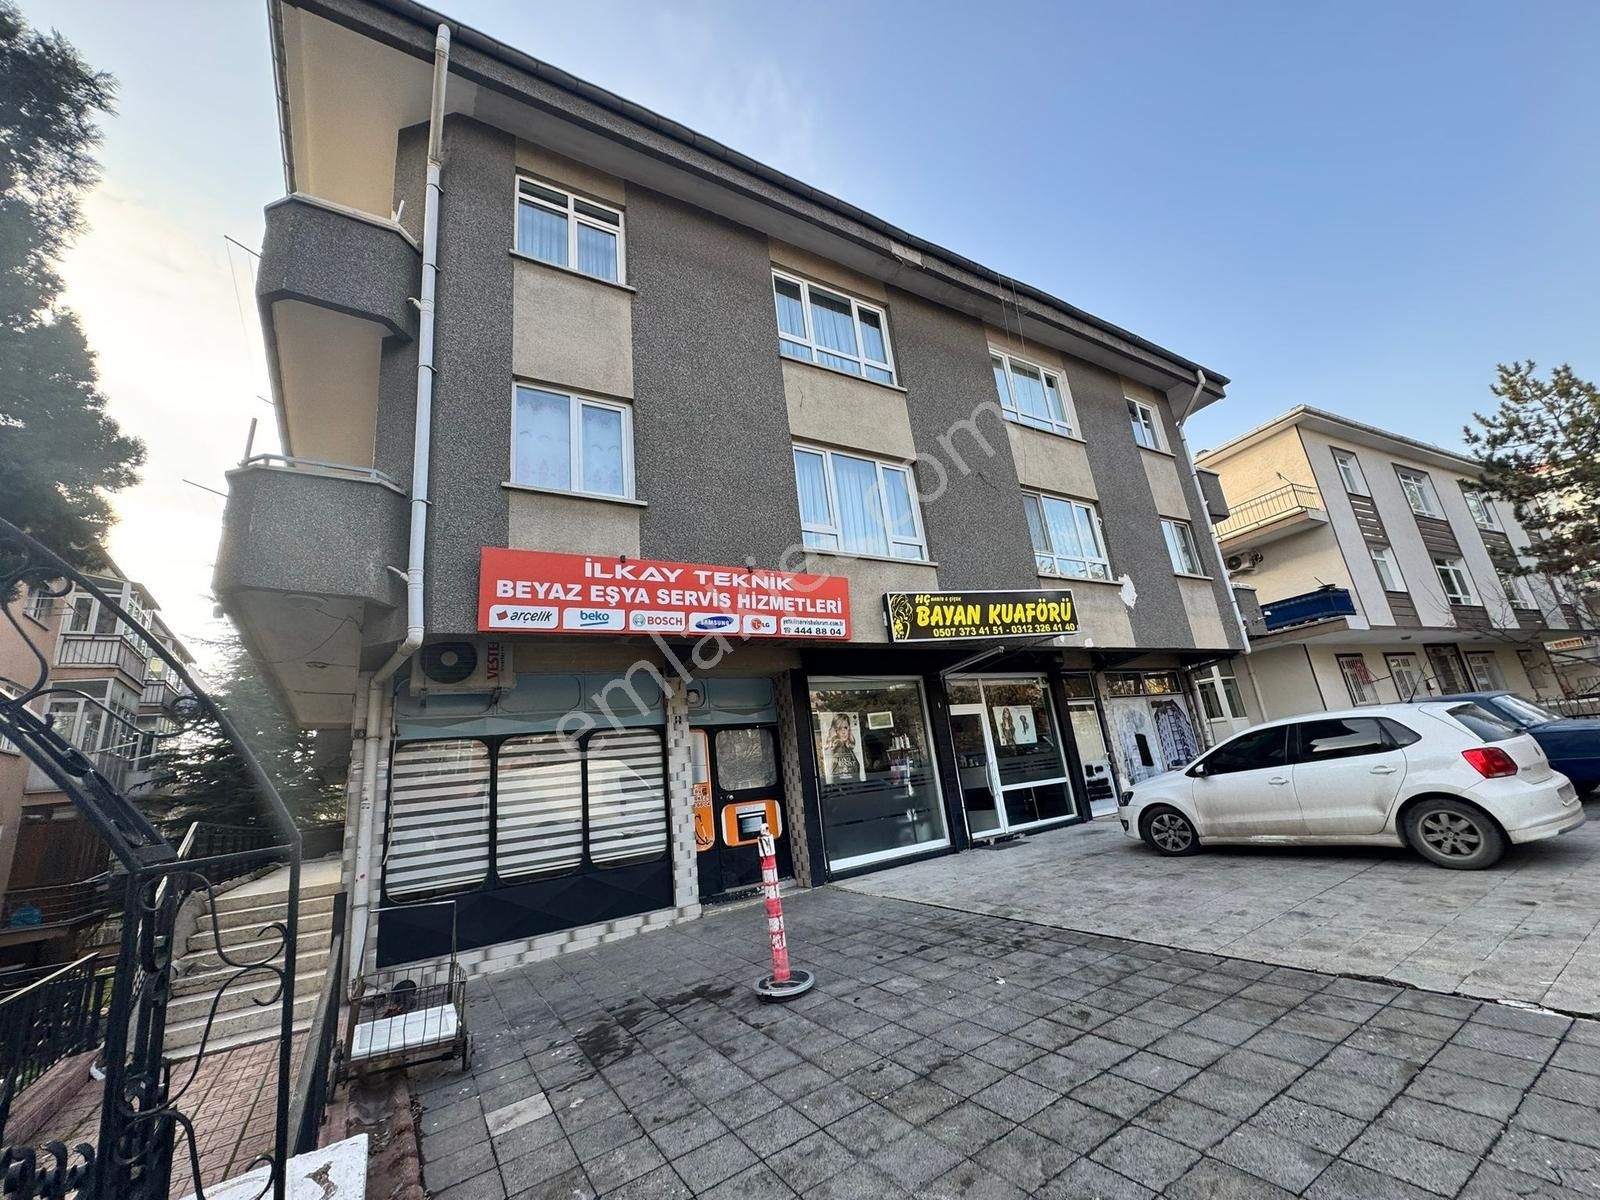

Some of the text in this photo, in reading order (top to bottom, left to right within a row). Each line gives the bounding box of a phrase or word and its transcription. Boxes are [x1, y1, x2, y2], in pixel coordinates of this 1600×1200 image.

[584, 557, 794, 591] İLKAY TEKNİK
[496, 579, 842, 614] BEYAZ EŞYA SERVİS HİZMETLERİ
[915, 594, 931, 606] HÇ
[510, 610, 553, 624] arçelik
[579, 610, 610, 621] beko
[916, 598, 1072, 627] BAYAN KUAFÖRÜ
[647, 616, 683, 626] BOSCH
[700, 618, 730, 627] SAMSUNG
[794, 626, 842, 636] 444 88 04
[933, 628, 956, 637] 0507
[959, 626, 977, 636] 373
[979, 626, 990, 635] 41
[992, 625, 1003, 635] 51
[1011, 624, 1033, 633] 0312
[1034, 623, 1051, 632] 326
[1053, 623, 1063, 632] 41
[1065, 622, 1076, 631] 40
